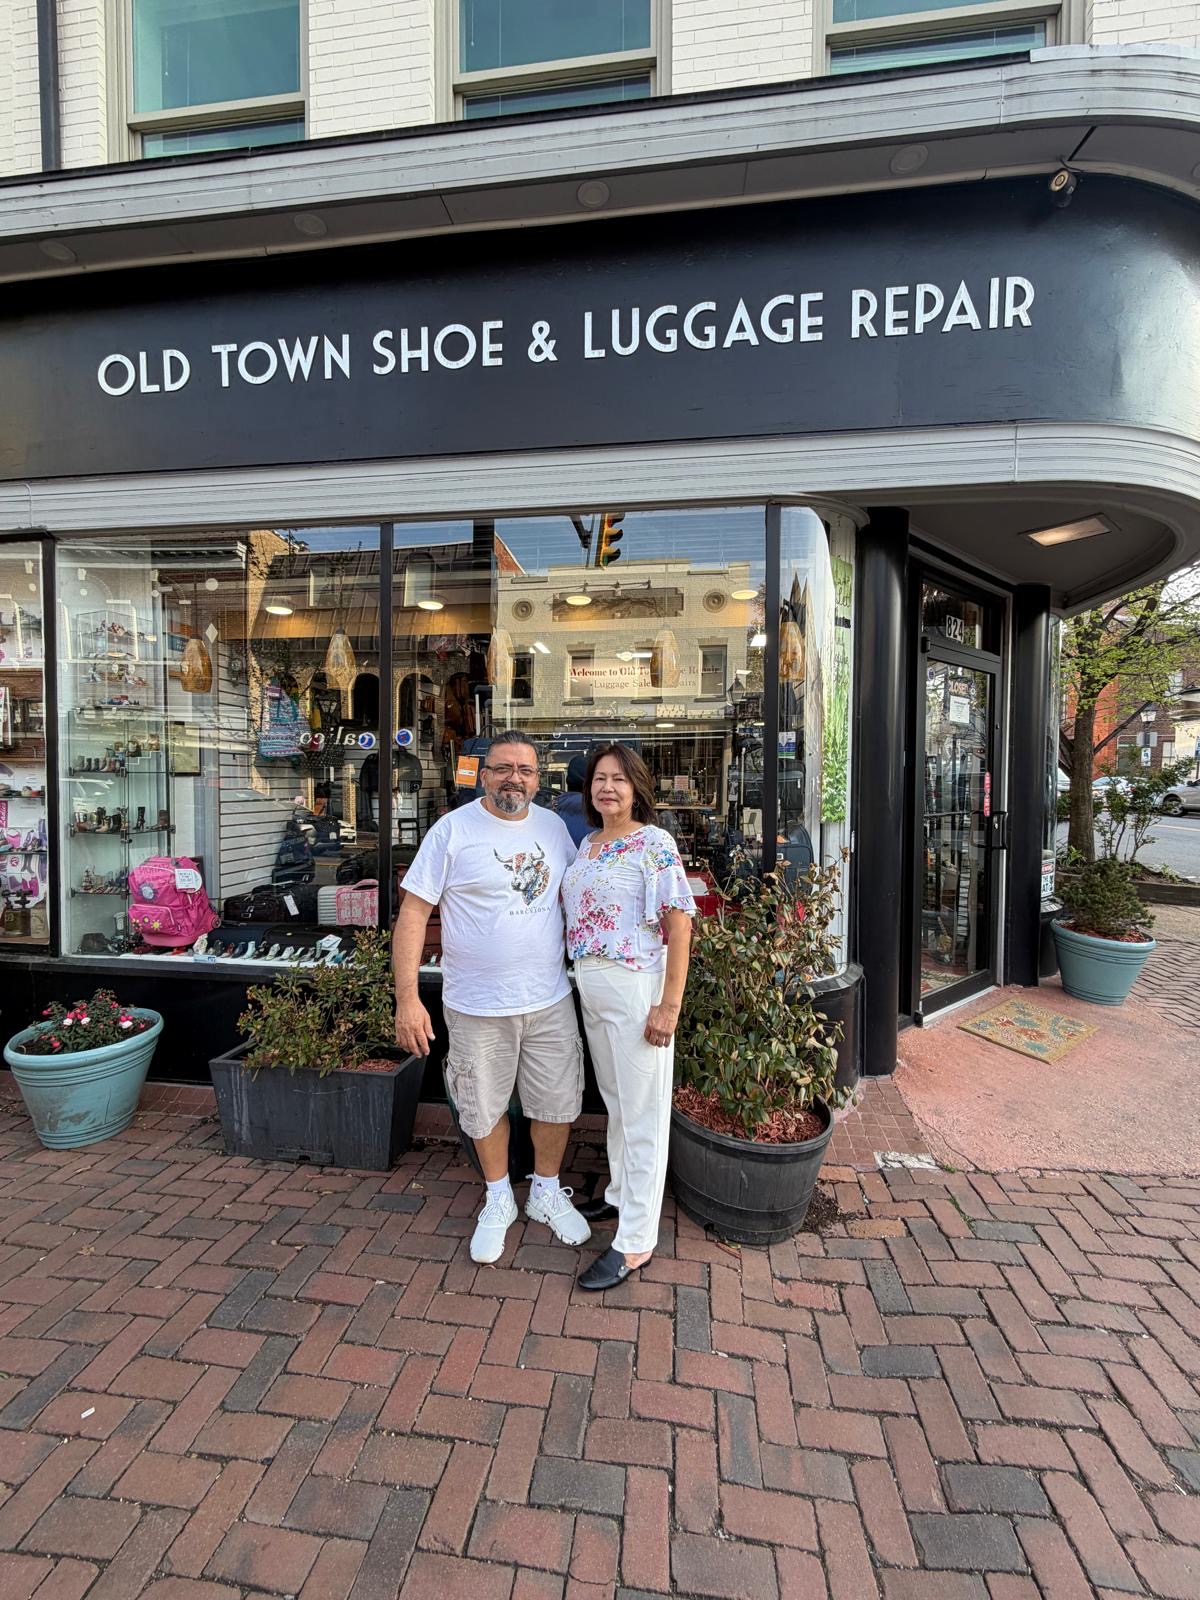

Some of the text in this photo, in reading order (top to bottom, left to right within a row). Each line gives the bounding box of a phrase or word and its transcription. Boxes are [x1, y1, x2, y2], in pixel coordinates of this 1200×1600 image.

[97, 276, 1035, 396] OLD TOWN SHOE & LUGGAGE REPAIR
[947, 616, 963, 641] 824
[609, 667, 617, 676] to
[618, 666, 636, 677] Old
[594, 680, 630, 690] Luggage
[632, 679, 652, 688] Sale
